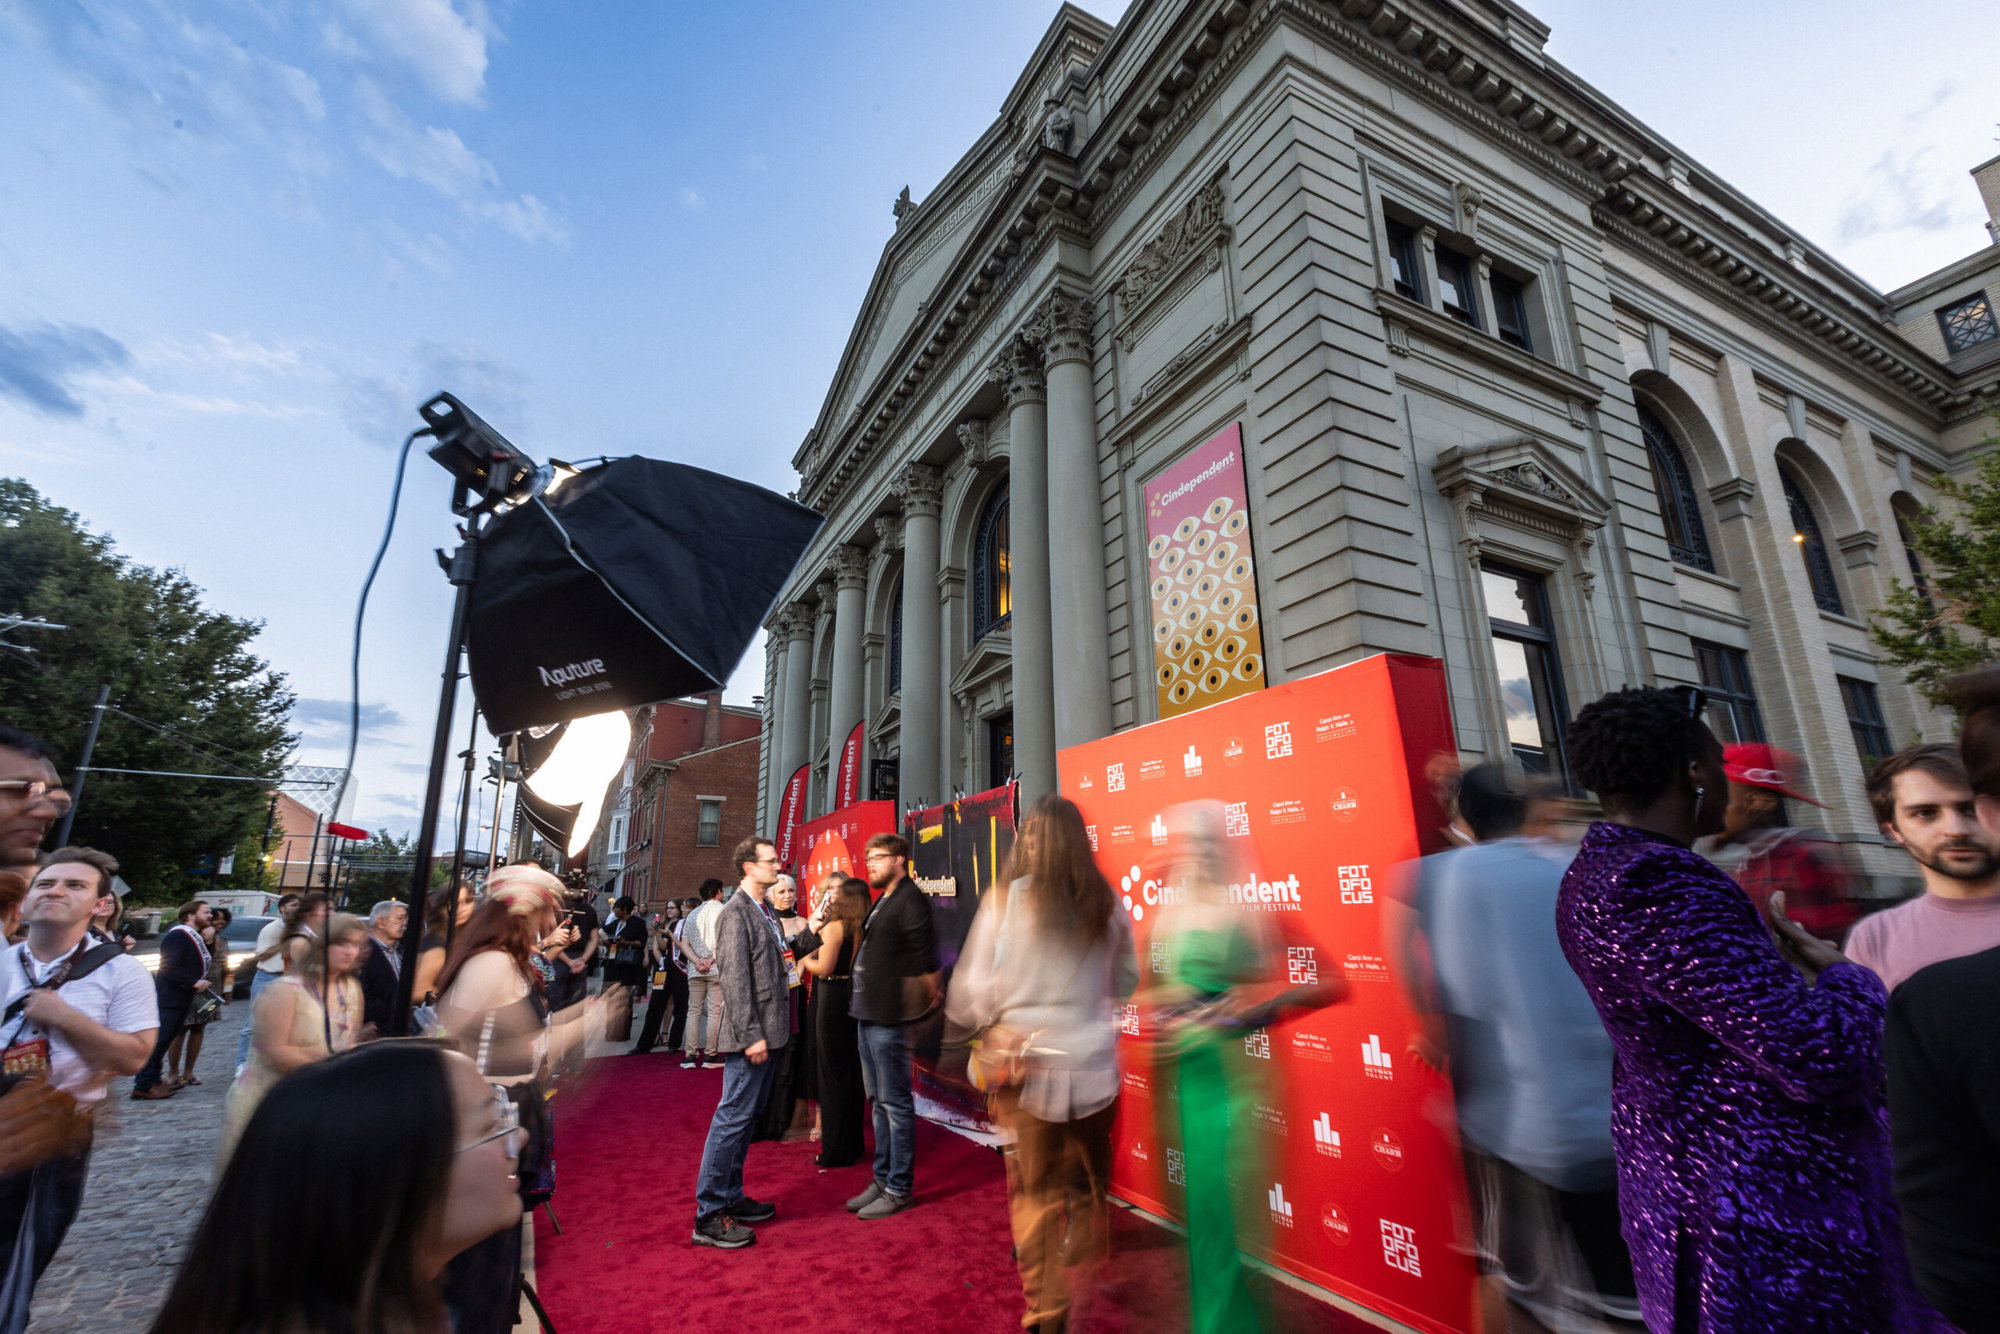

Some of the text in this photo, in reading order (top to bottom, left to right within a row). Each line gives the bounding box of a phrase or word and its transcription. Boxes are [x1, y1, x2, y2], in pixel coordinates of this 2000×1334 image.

[1161, 451, 1235, 506] Cindependent
[537, 658, 607, 687] Aputure
[1264, 721, 1290, 737] FOT
[1265, 733, 1292, 748] OFO
[1267, 744, 1293, 759] CUS
[843, 740, 856, 808] ependent
[1106, 762, 1124, 775] FOT
[1107, 772, 1125, 784] OFO
[1108, 781, 1126, 793] CUS
[1224, 801, 1247, 815] FOT
[781, 778, 800, 862] Cindependent
[1225, 813, 1249, 826] OFO
[1226, 824, 1250, 837] CUS
[1338, 865, 1369, 878] FOT
[1142, 872, 1302, 906] Cindendent
[1339, 878, 1372, 891] OFO
[1341, 891, 1373, 905] CUS
[1262, 902, 1302, 913] FESTIVAL
[1287, 947, 1315, 959] FOT
[1288, 959, 1317, 972] OFO
[1289, 971, 1318, 985] CUS
[1245, 1044, 1271, 1059] CUS
[1379, 1218, 1416, 1244] FOT
[1381, 1234, 1420, 1262] OFO
[1383, 1250, 1422, 1279] CUS
